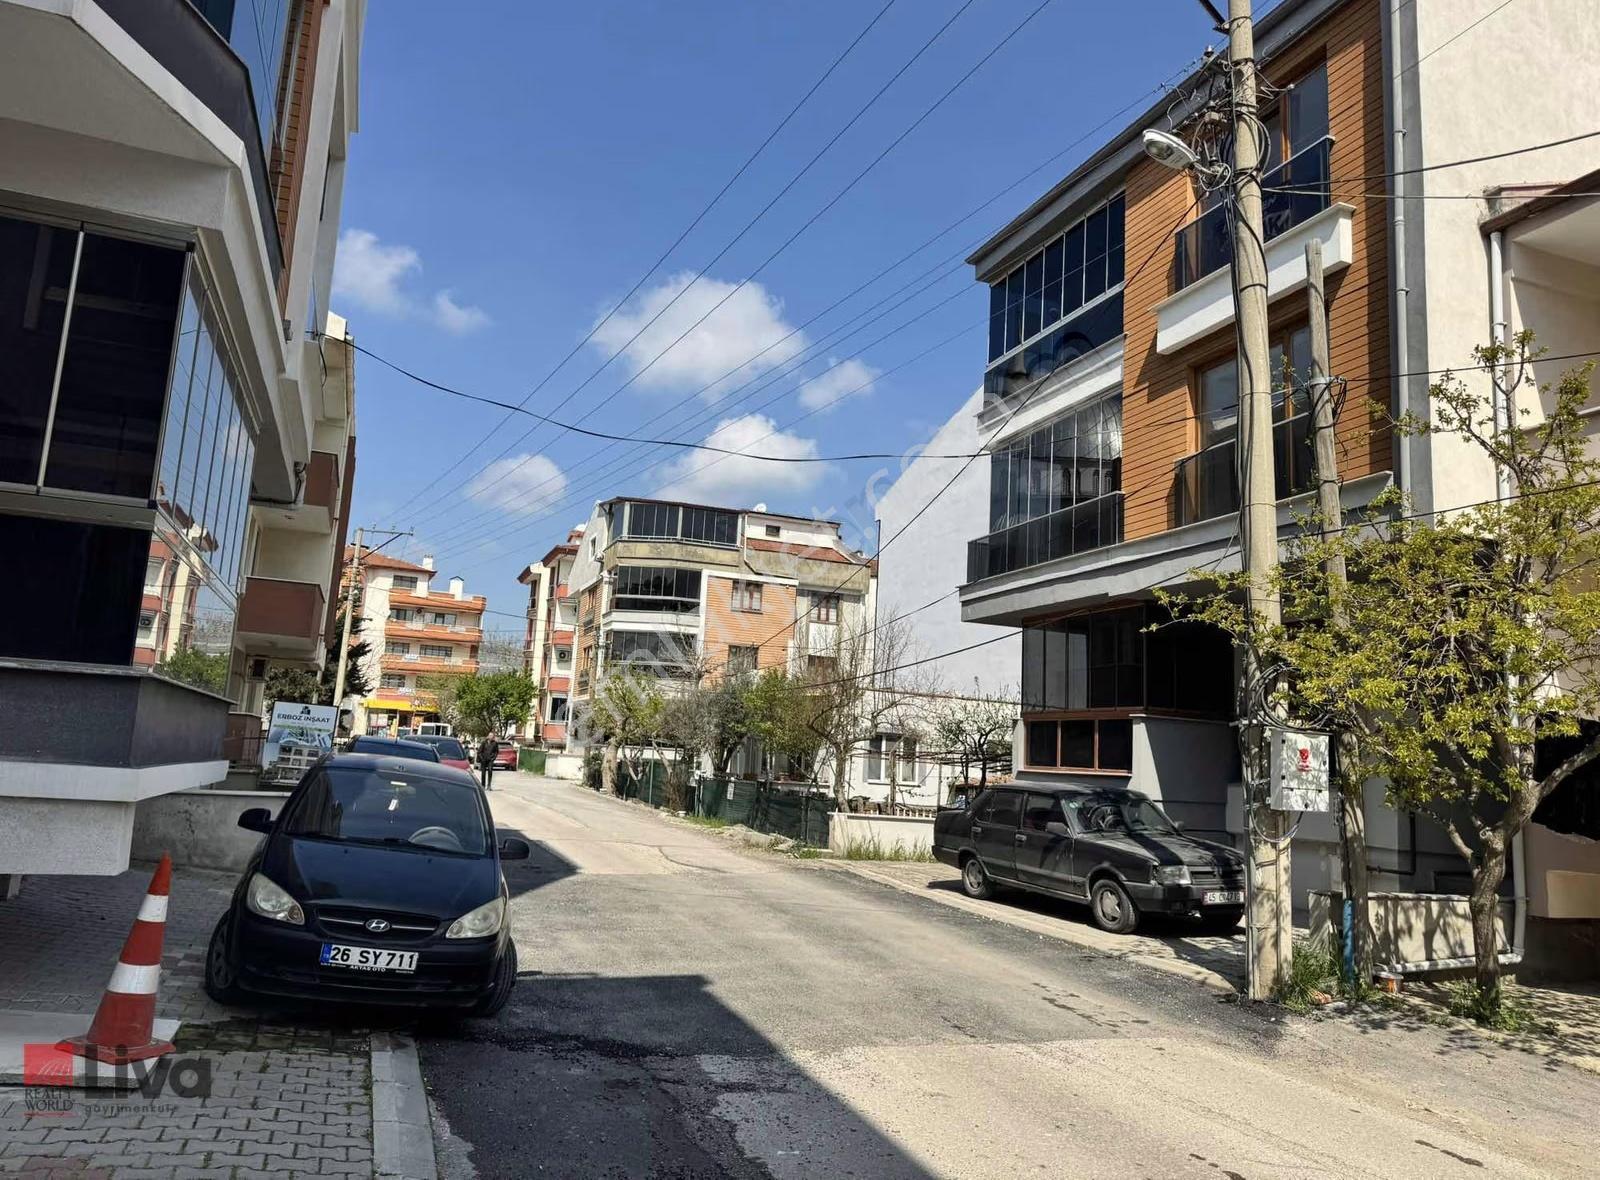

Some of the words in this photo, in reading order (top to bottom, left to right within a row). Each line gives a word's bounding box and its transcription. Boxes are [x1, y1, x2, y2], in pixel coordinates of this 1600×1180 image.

[330, 946, 351, 962] 26
[358, 949, 382, 965] SY
[385, 952, 415, 969] 711
